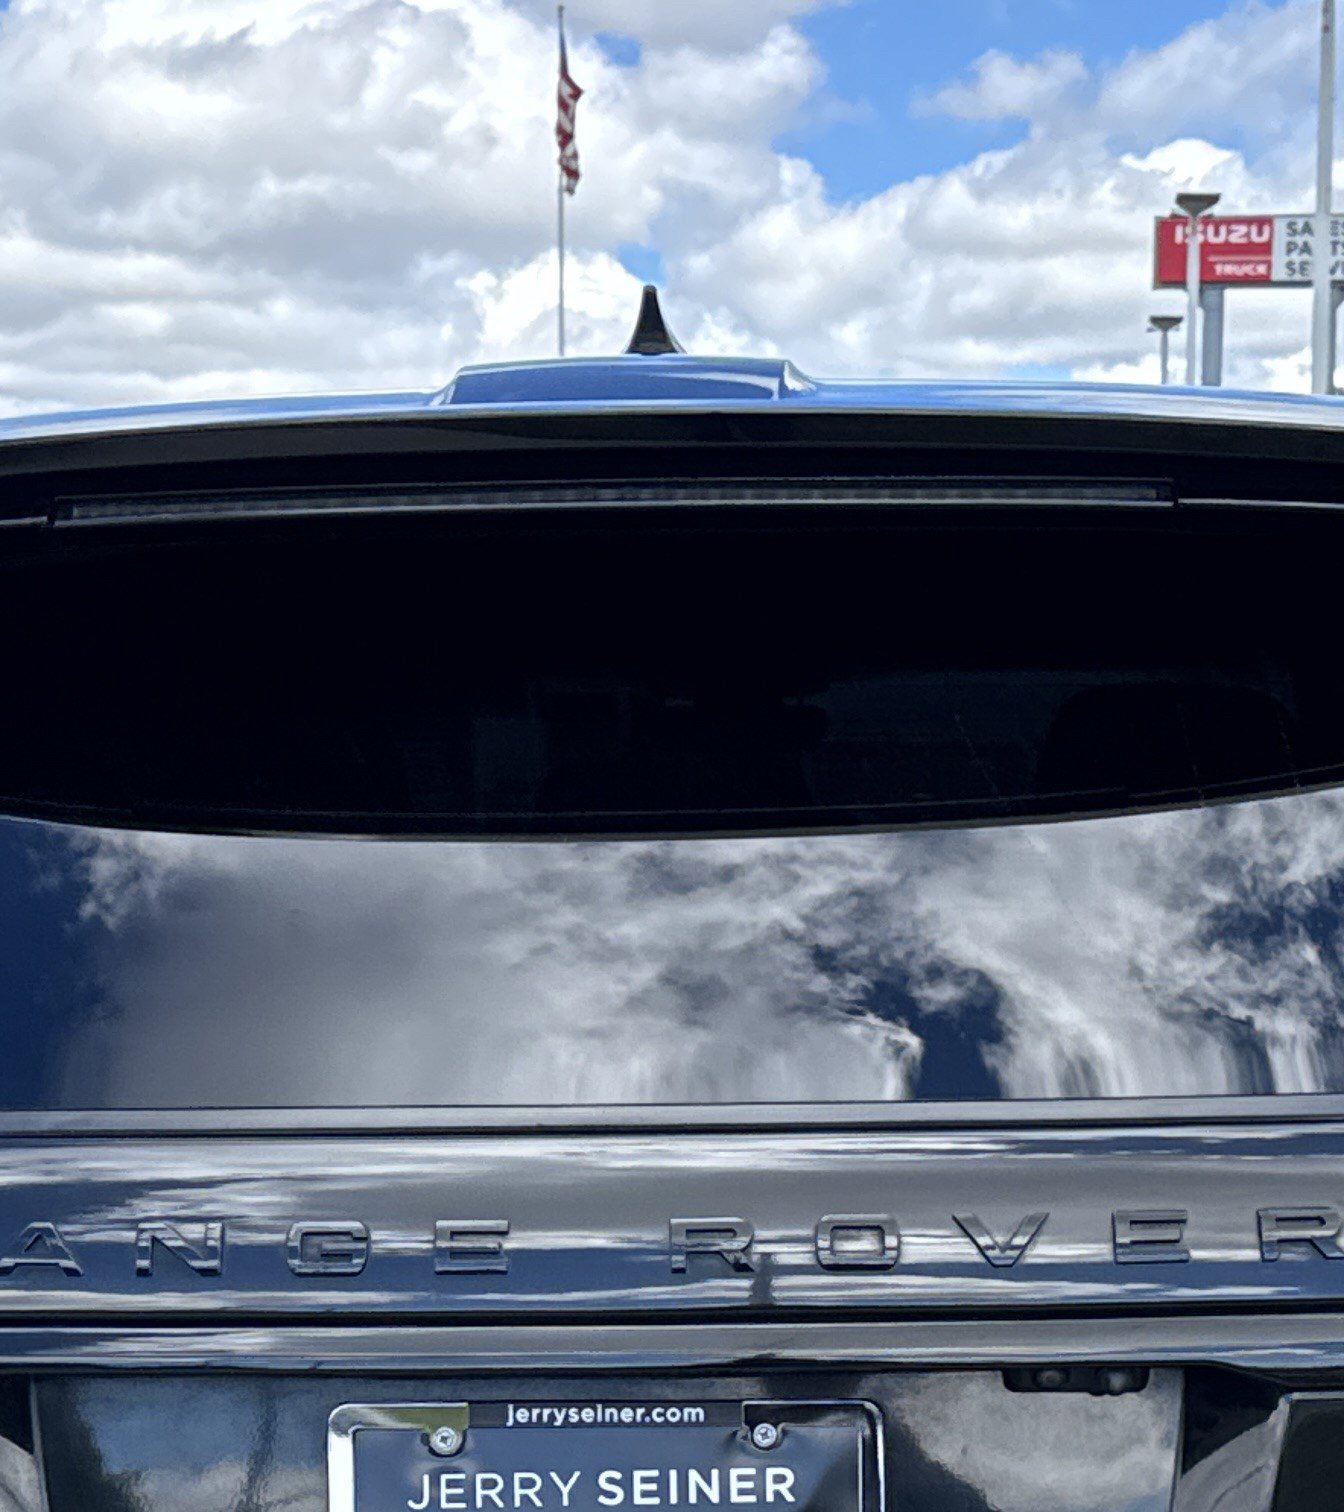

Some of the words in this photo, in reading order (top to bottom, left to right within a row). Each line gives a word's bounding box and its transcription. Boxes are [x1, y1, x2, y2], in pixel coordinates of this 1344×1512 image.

[1213, 263, 1270, 277] TRUCK
[505, 1403, 705, 1427] jerryseiner.com
[406, 1470, 582, 1510] JERRY
[597, 1466, 796, 1506] SEINER
